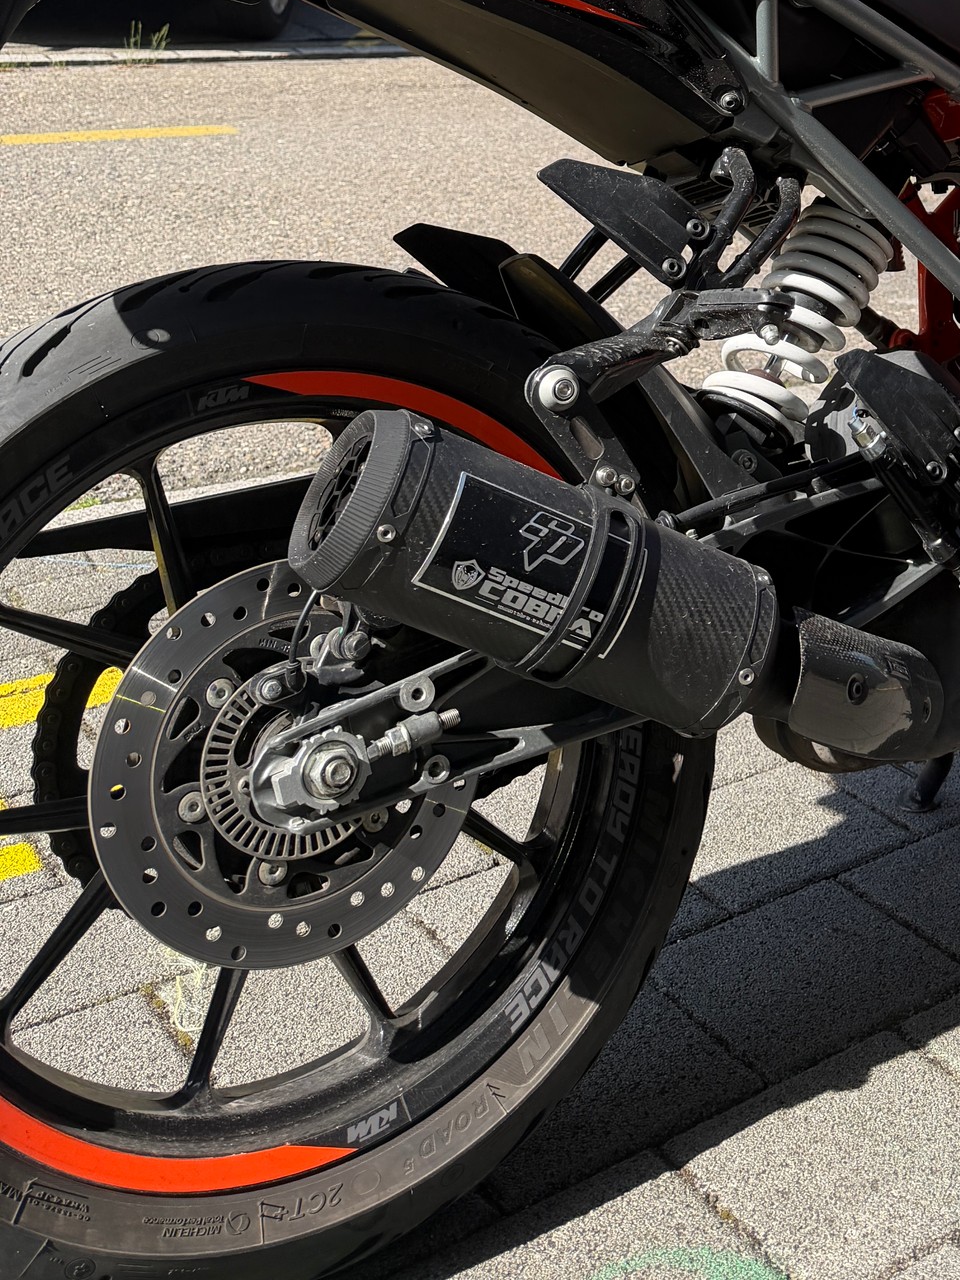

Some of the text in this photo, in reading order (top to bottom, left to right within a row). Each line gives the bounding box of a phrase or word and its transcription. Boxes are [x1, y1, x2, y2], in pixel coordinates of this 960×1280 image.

[197, 385, 250, 412] KTM
[0, 454, 75, 540] ACE
[504, 722, 644, 1034] EADY TO RACE
[346, 1101, 398, 1145] KTM
[419, 1093, 490, 1161] ROAD
[161, 1225, 222, 1238] MICHELIN
